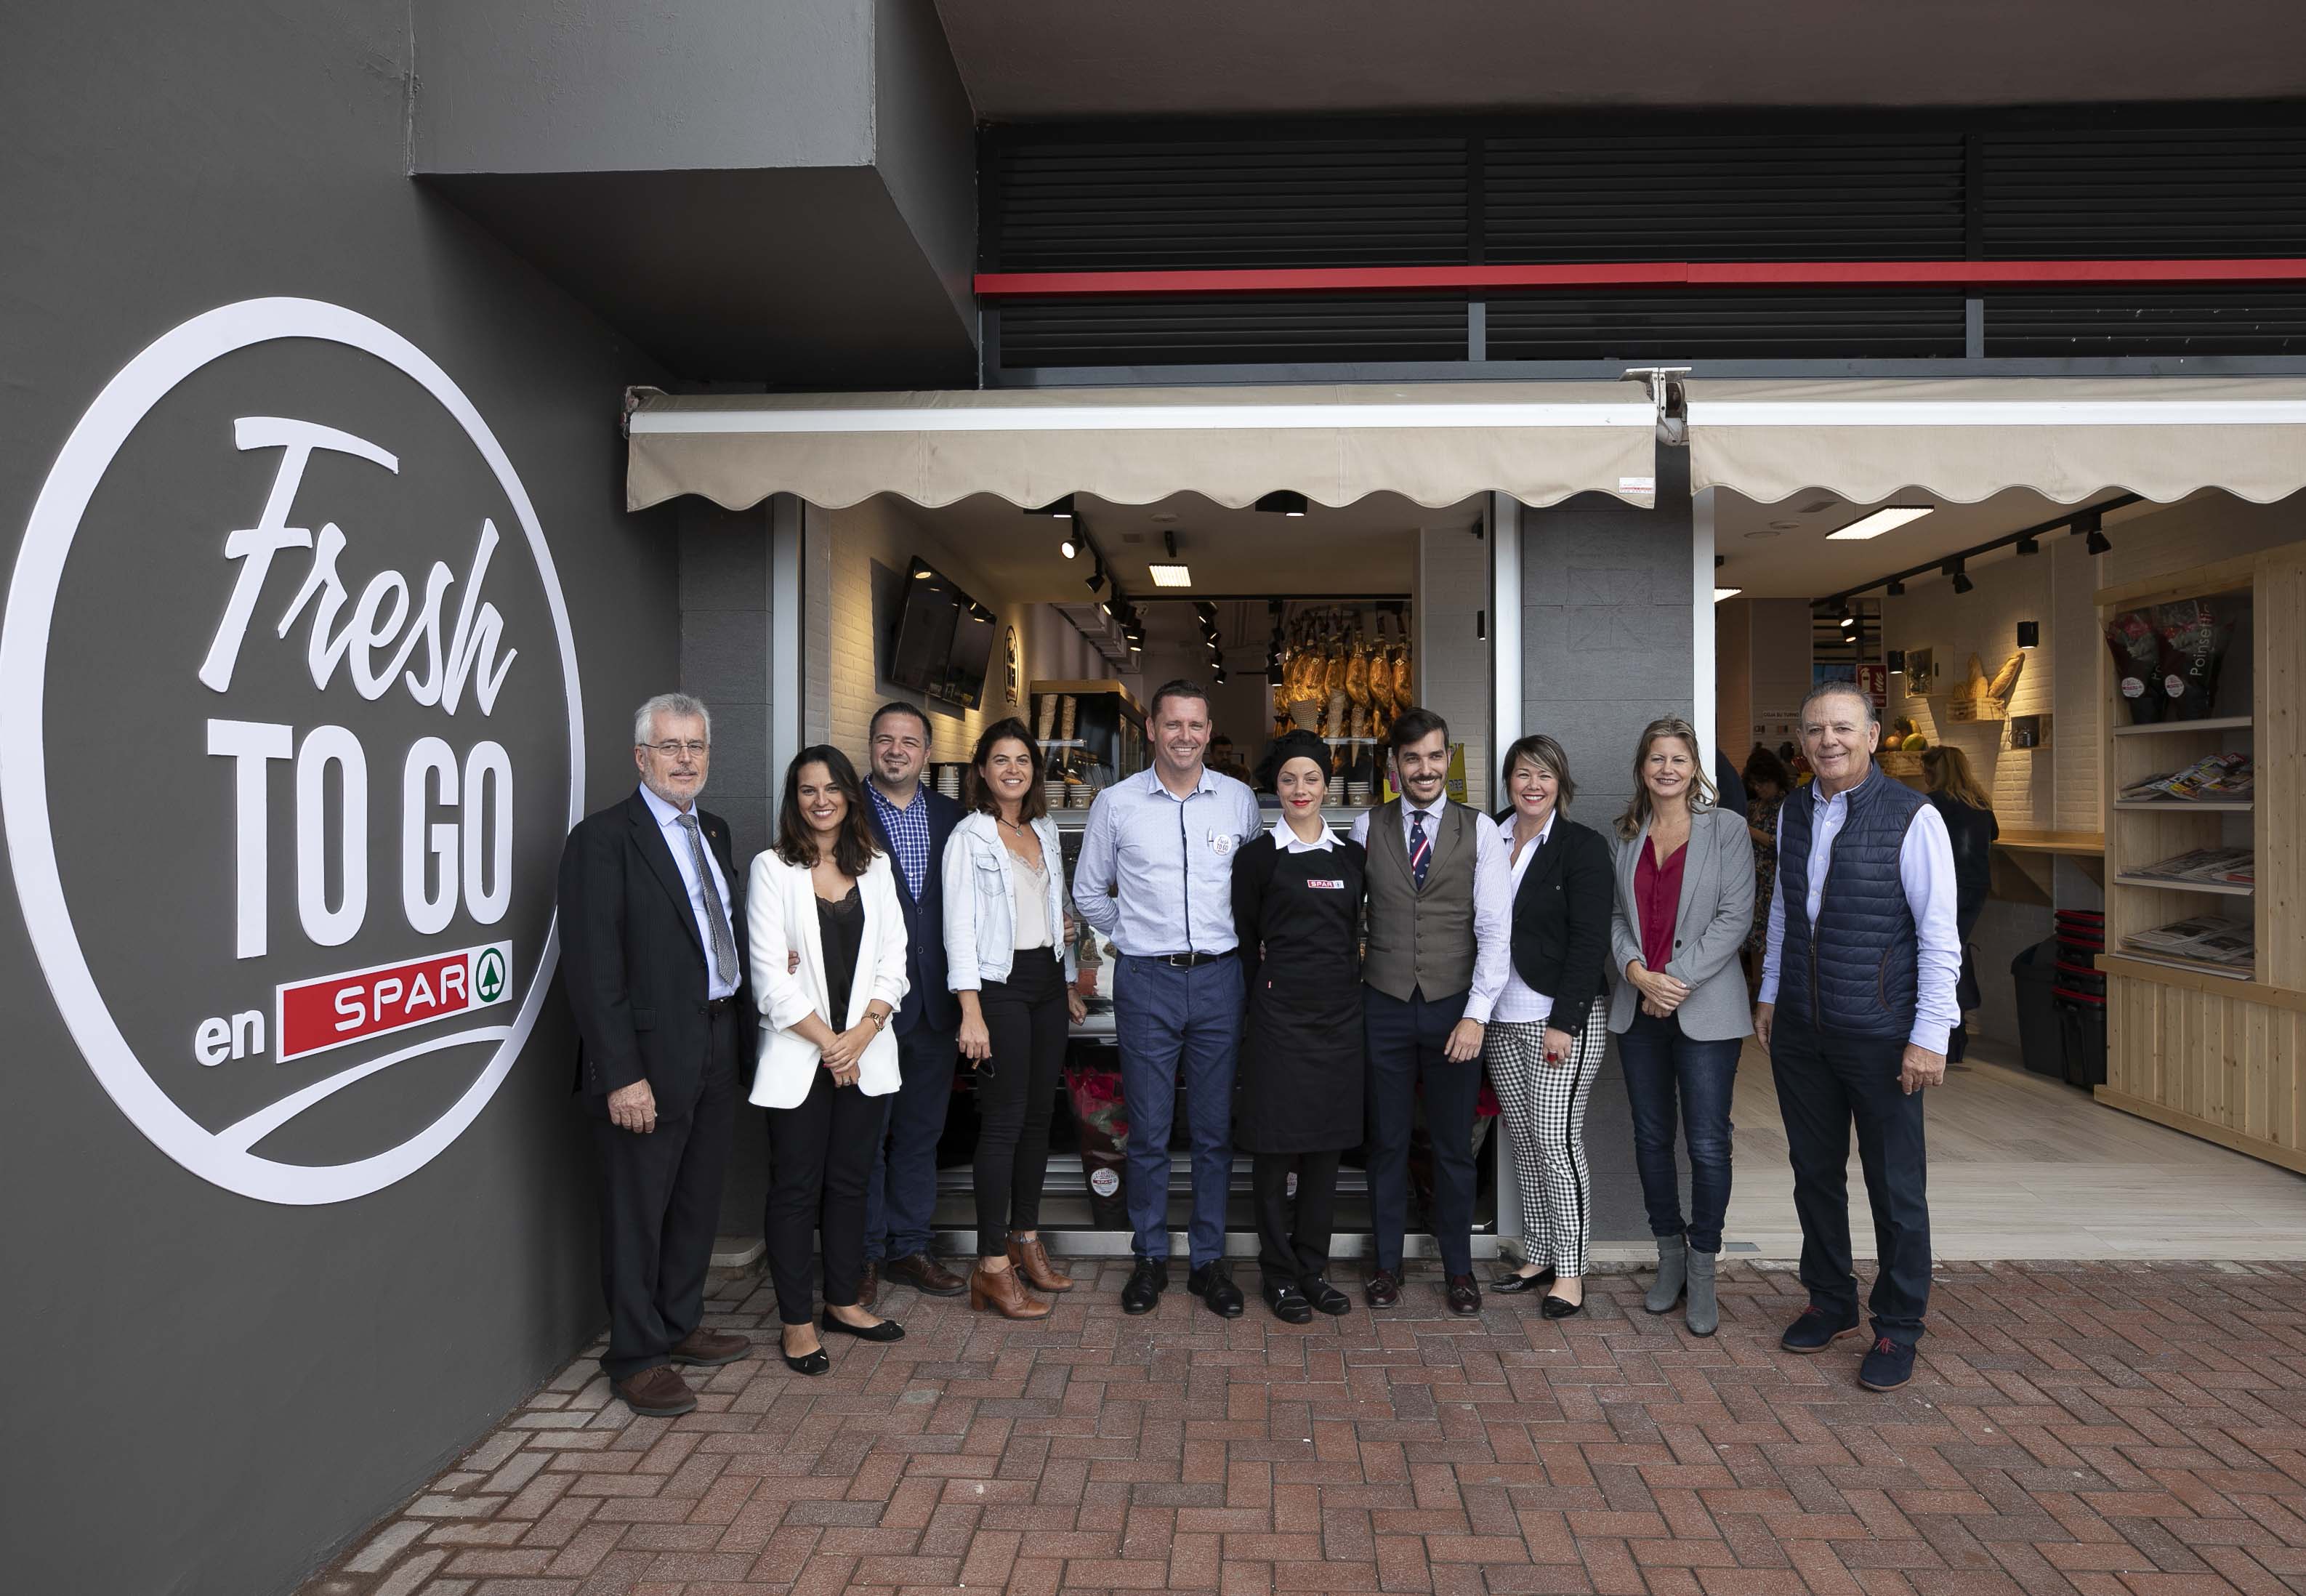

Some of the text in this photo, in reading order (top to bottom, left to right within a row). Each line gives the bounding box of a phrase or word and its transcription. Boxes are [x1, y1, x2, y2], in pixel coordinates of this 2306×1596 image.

[198, 416, 518, 716] Fresh
[207, 718, 513, 959] TO GO
[195, 964, 466, 1066] en SPAR
